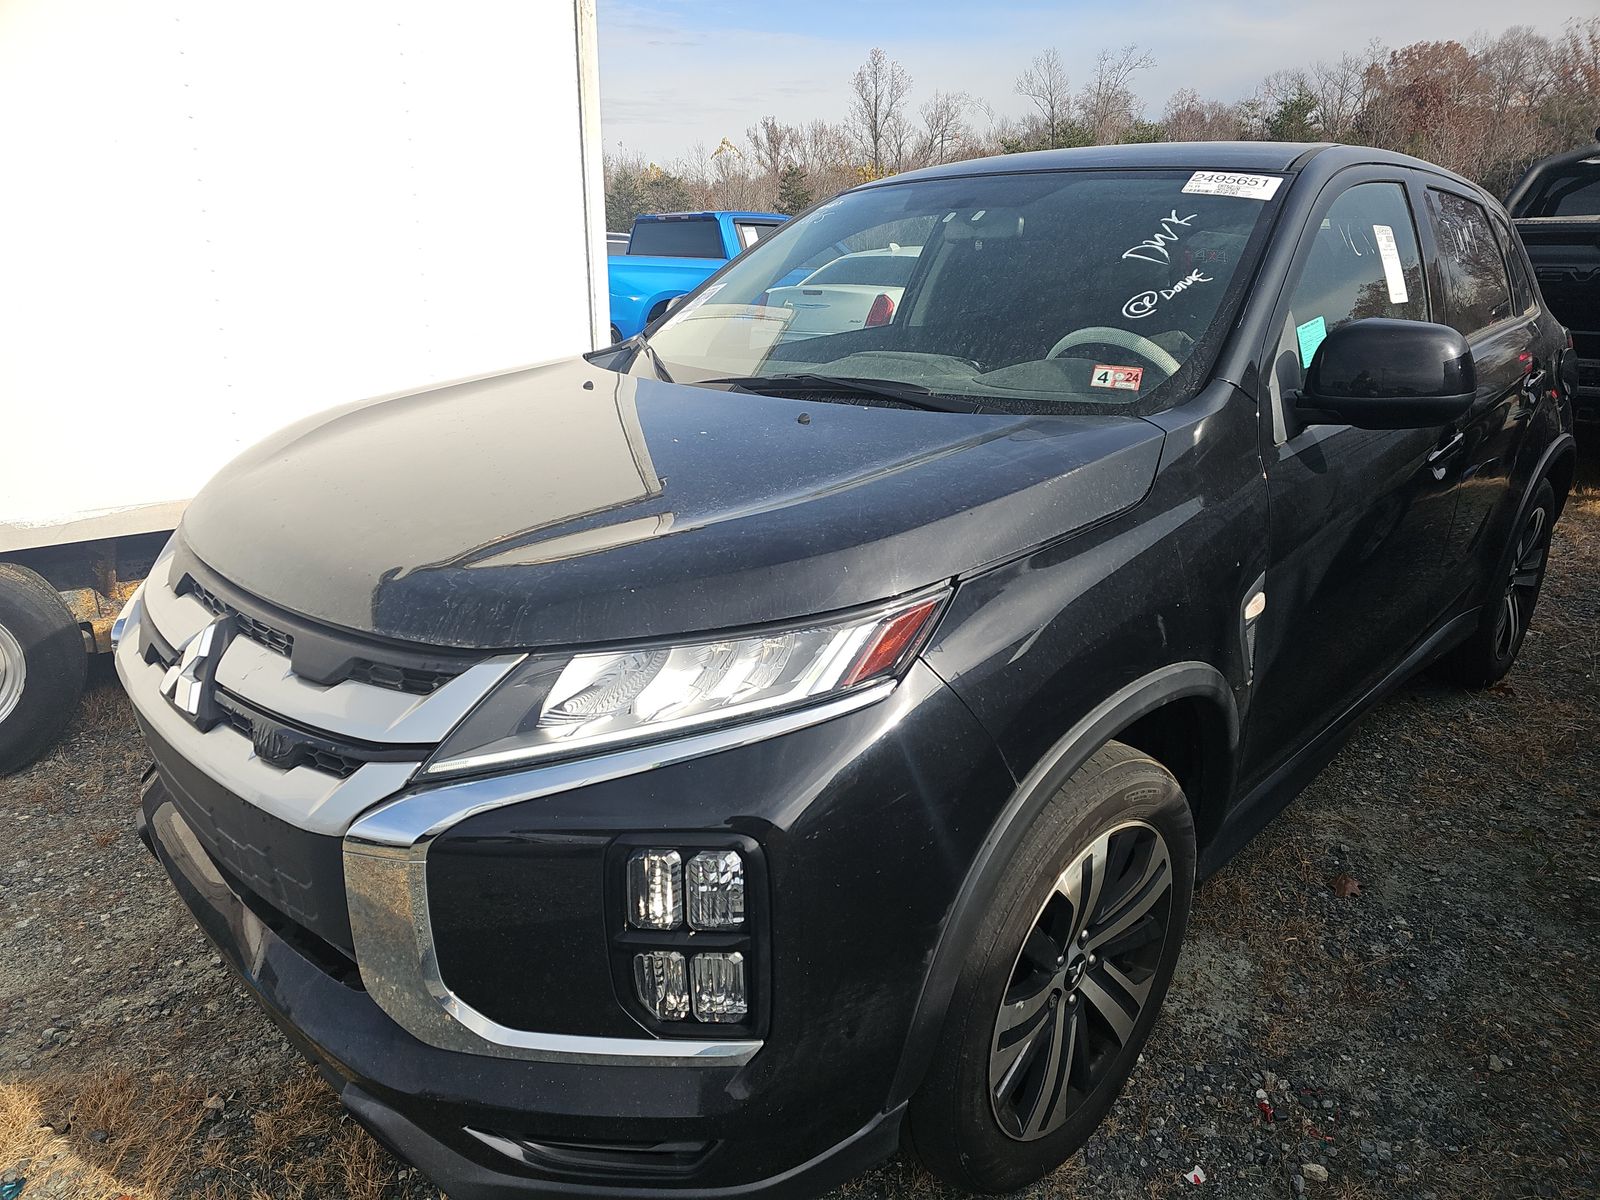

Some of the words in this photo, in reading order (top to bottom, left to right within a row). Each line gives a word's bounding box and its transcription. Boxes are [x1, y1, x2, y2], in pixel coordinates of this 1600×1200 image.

[1191, 173, 1270, 188] 2495651
[1097, 371, 1109, 384] 4
[1125, 372, 1140, 383] 24
